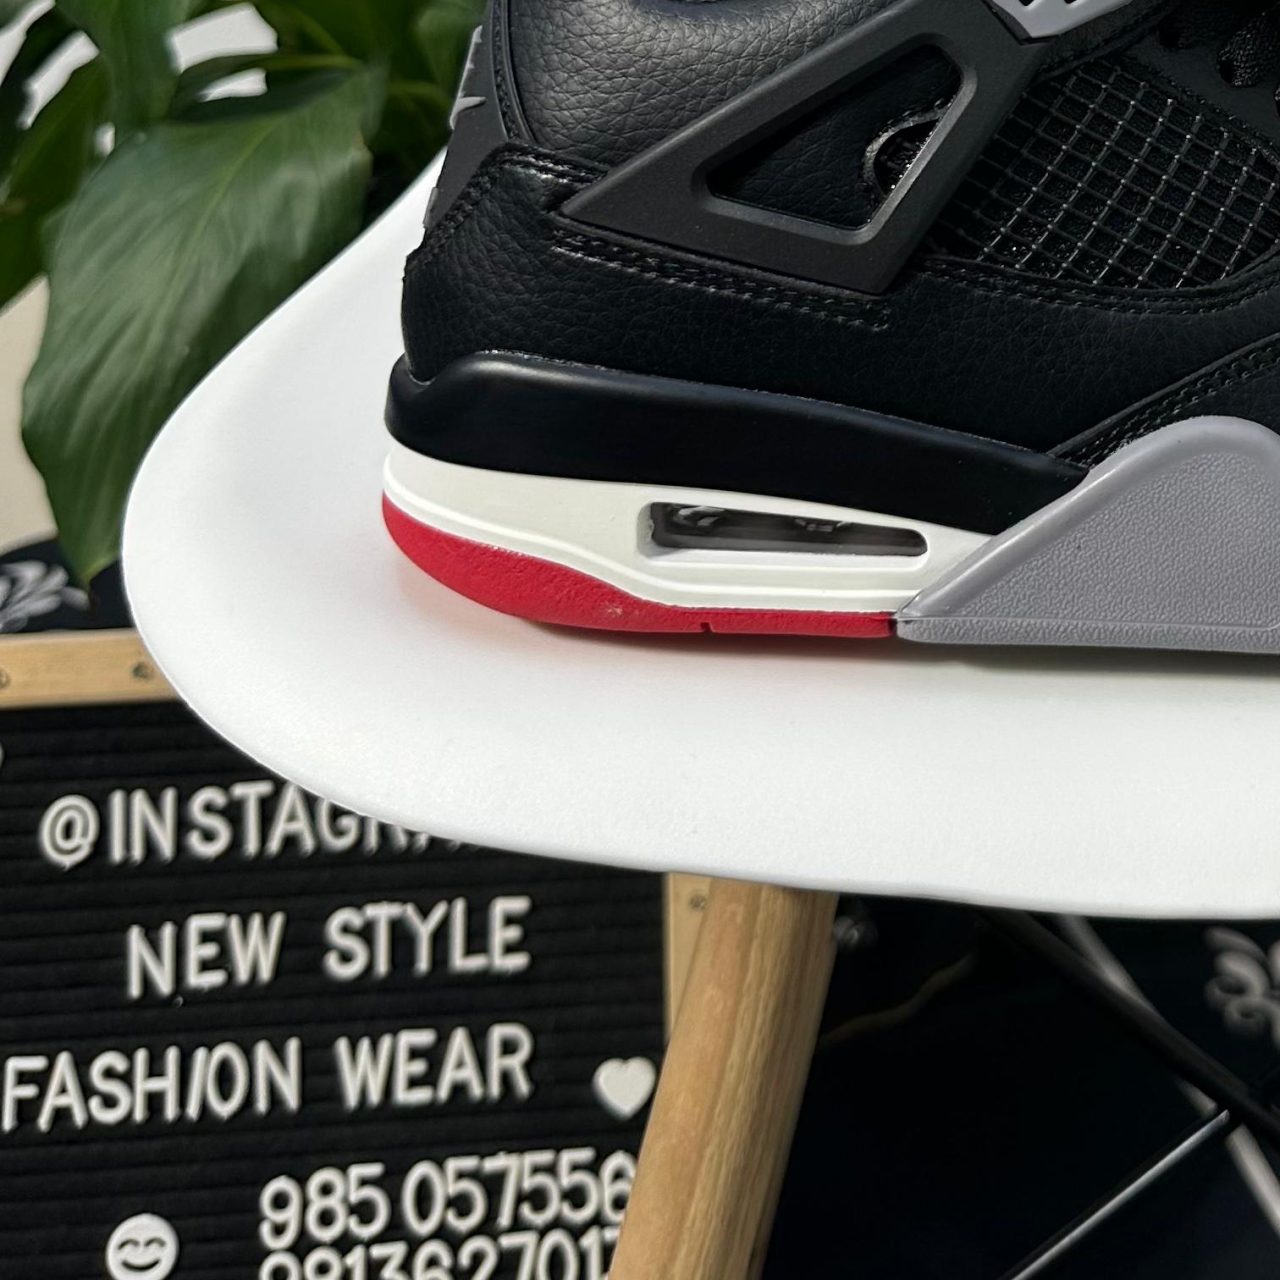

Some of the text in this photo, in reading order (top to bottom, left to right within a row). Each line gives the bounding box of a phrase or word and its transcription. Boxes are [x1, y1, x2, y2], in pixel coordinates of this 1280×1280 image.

[39, 779, 478, 869] @INSTAG
[128, 897, 529, 999] NEW STYLE
[2, 1024, 531, 1131] FASHION WEAR
